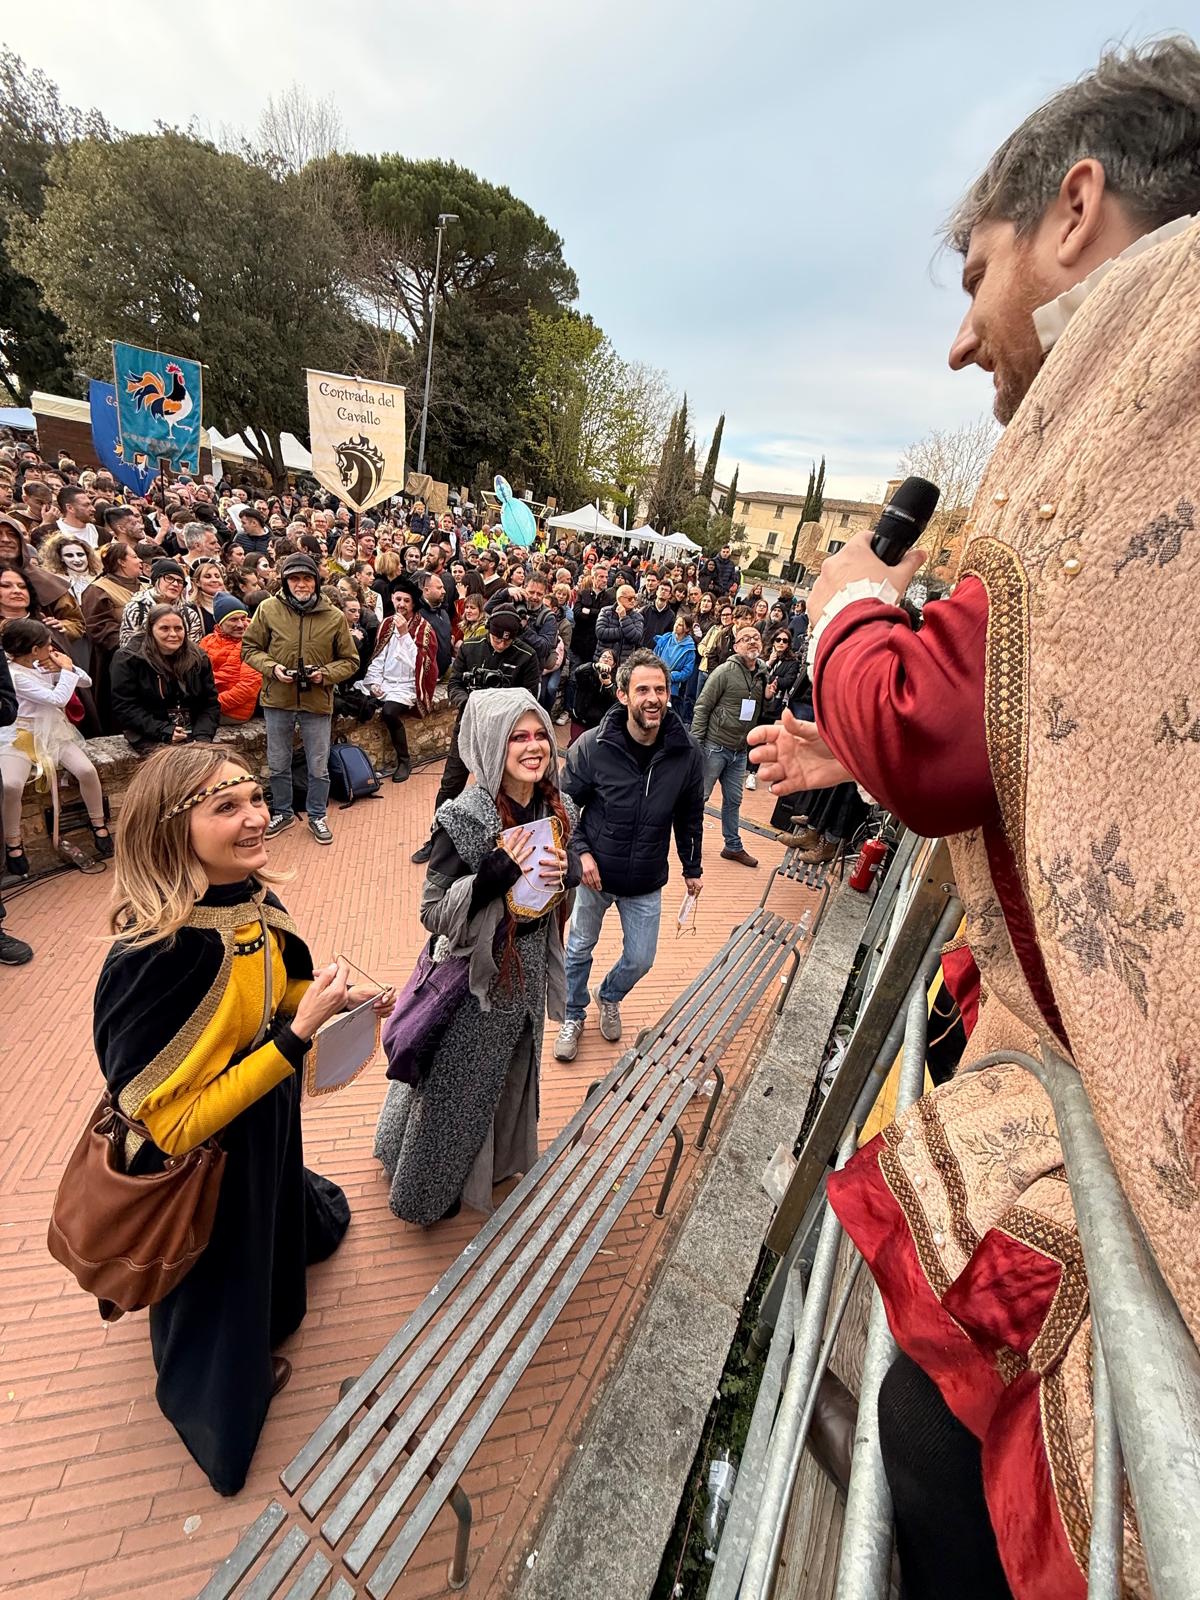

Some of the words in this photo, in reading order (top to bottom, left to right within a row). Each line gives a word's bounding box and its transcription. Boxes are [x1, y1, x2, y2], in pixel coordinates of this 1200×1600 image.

[319, 382, 375, 404] Contrada
[378, 392, 395, 408] del
[337, 406, 381, 425] Cavallo
